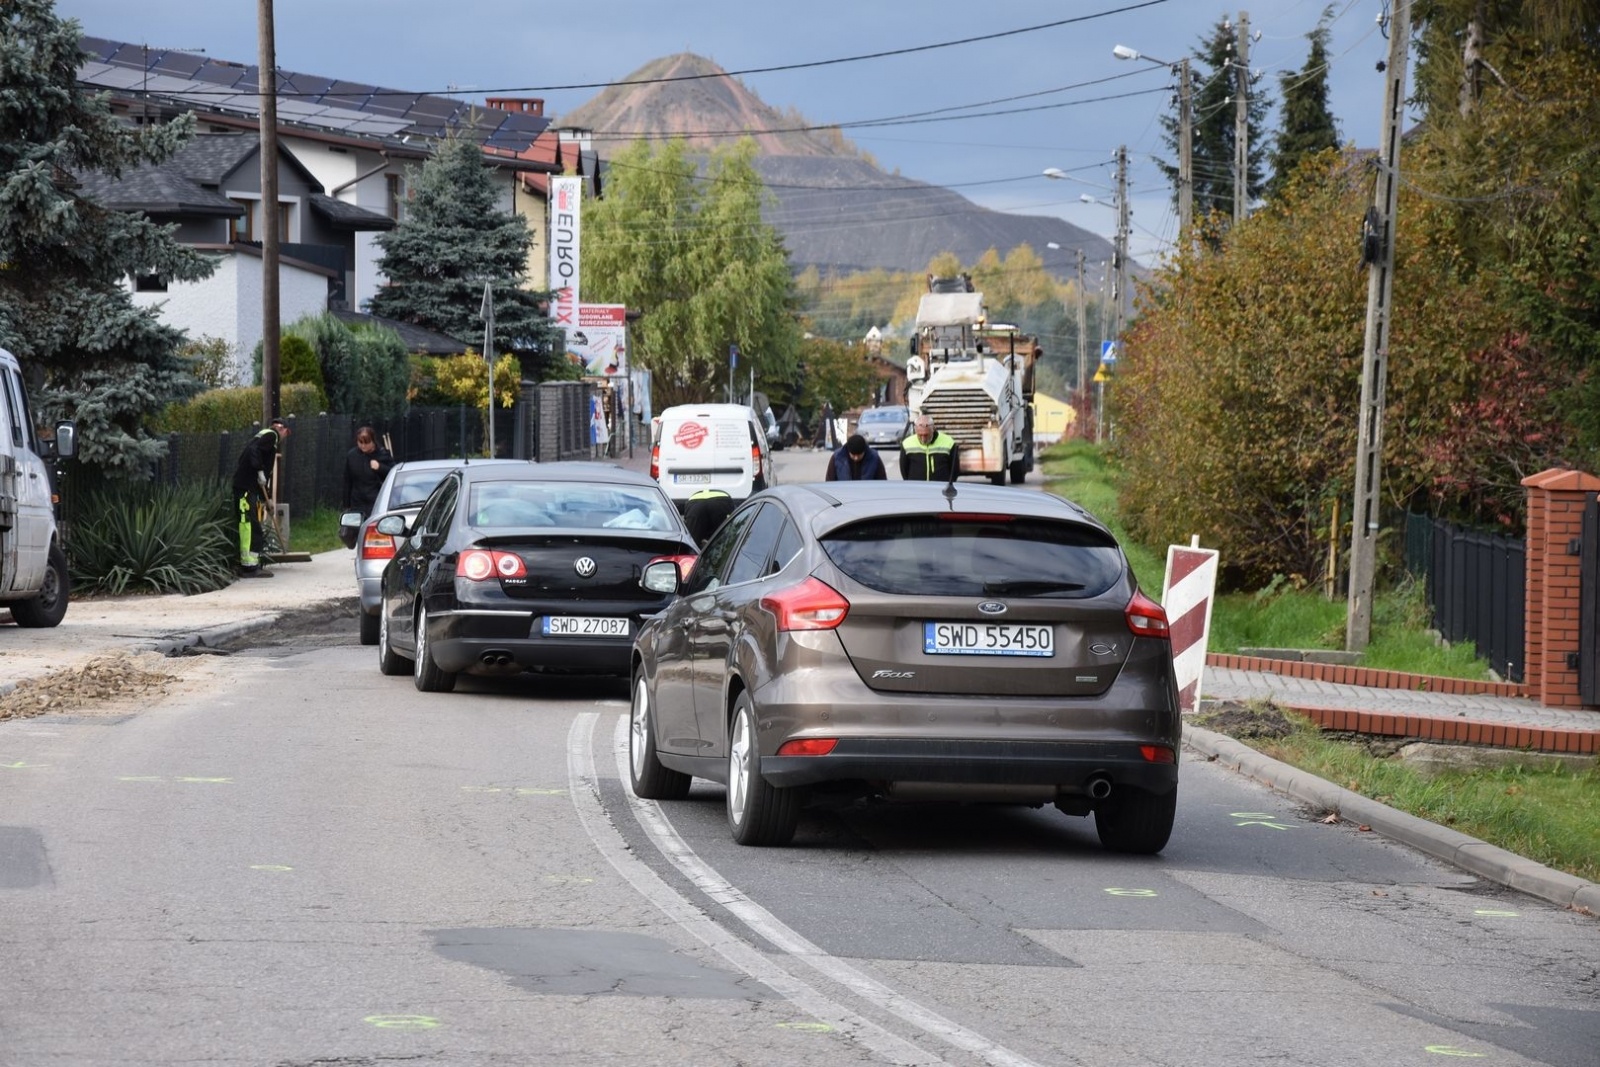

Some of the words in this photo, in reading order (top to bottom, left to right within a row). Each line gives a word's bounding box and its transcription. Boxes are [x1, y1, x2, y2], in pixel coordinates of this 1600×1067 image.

[551, 618, 579, 633] SWD
[583, 619, 627, 634] 27087
[938, 626, 978, 647] SWD
[985, 627, 1050, 649] 55450
